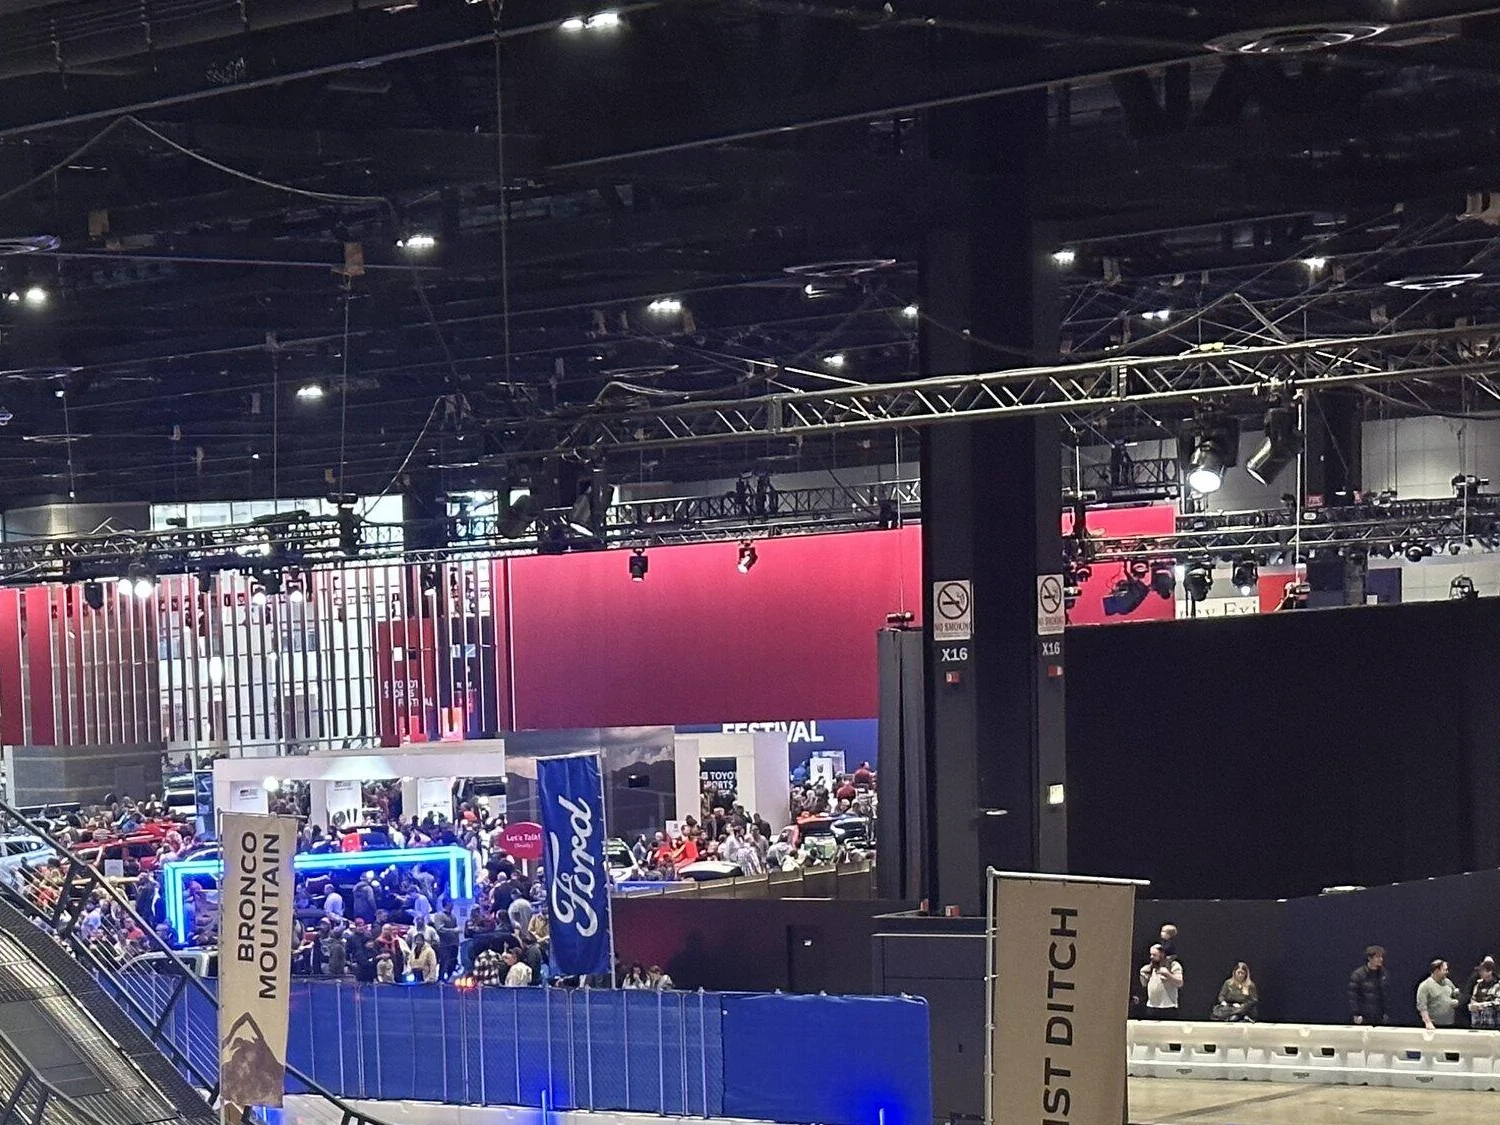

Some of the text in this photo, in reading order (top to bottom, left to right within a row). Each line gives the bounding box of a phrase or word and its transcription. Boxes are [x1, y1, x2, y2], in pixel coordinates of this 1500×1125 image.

[942, 647, 968, 661] X16
[1042, 641, 1060, 656] X16
[710, 771, 736, 780] TOYO
[237, 831, 257, 962] BRONCO
[259, 833, 280, 999] MOUNTAIN
[550, 795, 598, 938] Ford
[1045, 907, 1078, 1046] DITCH
